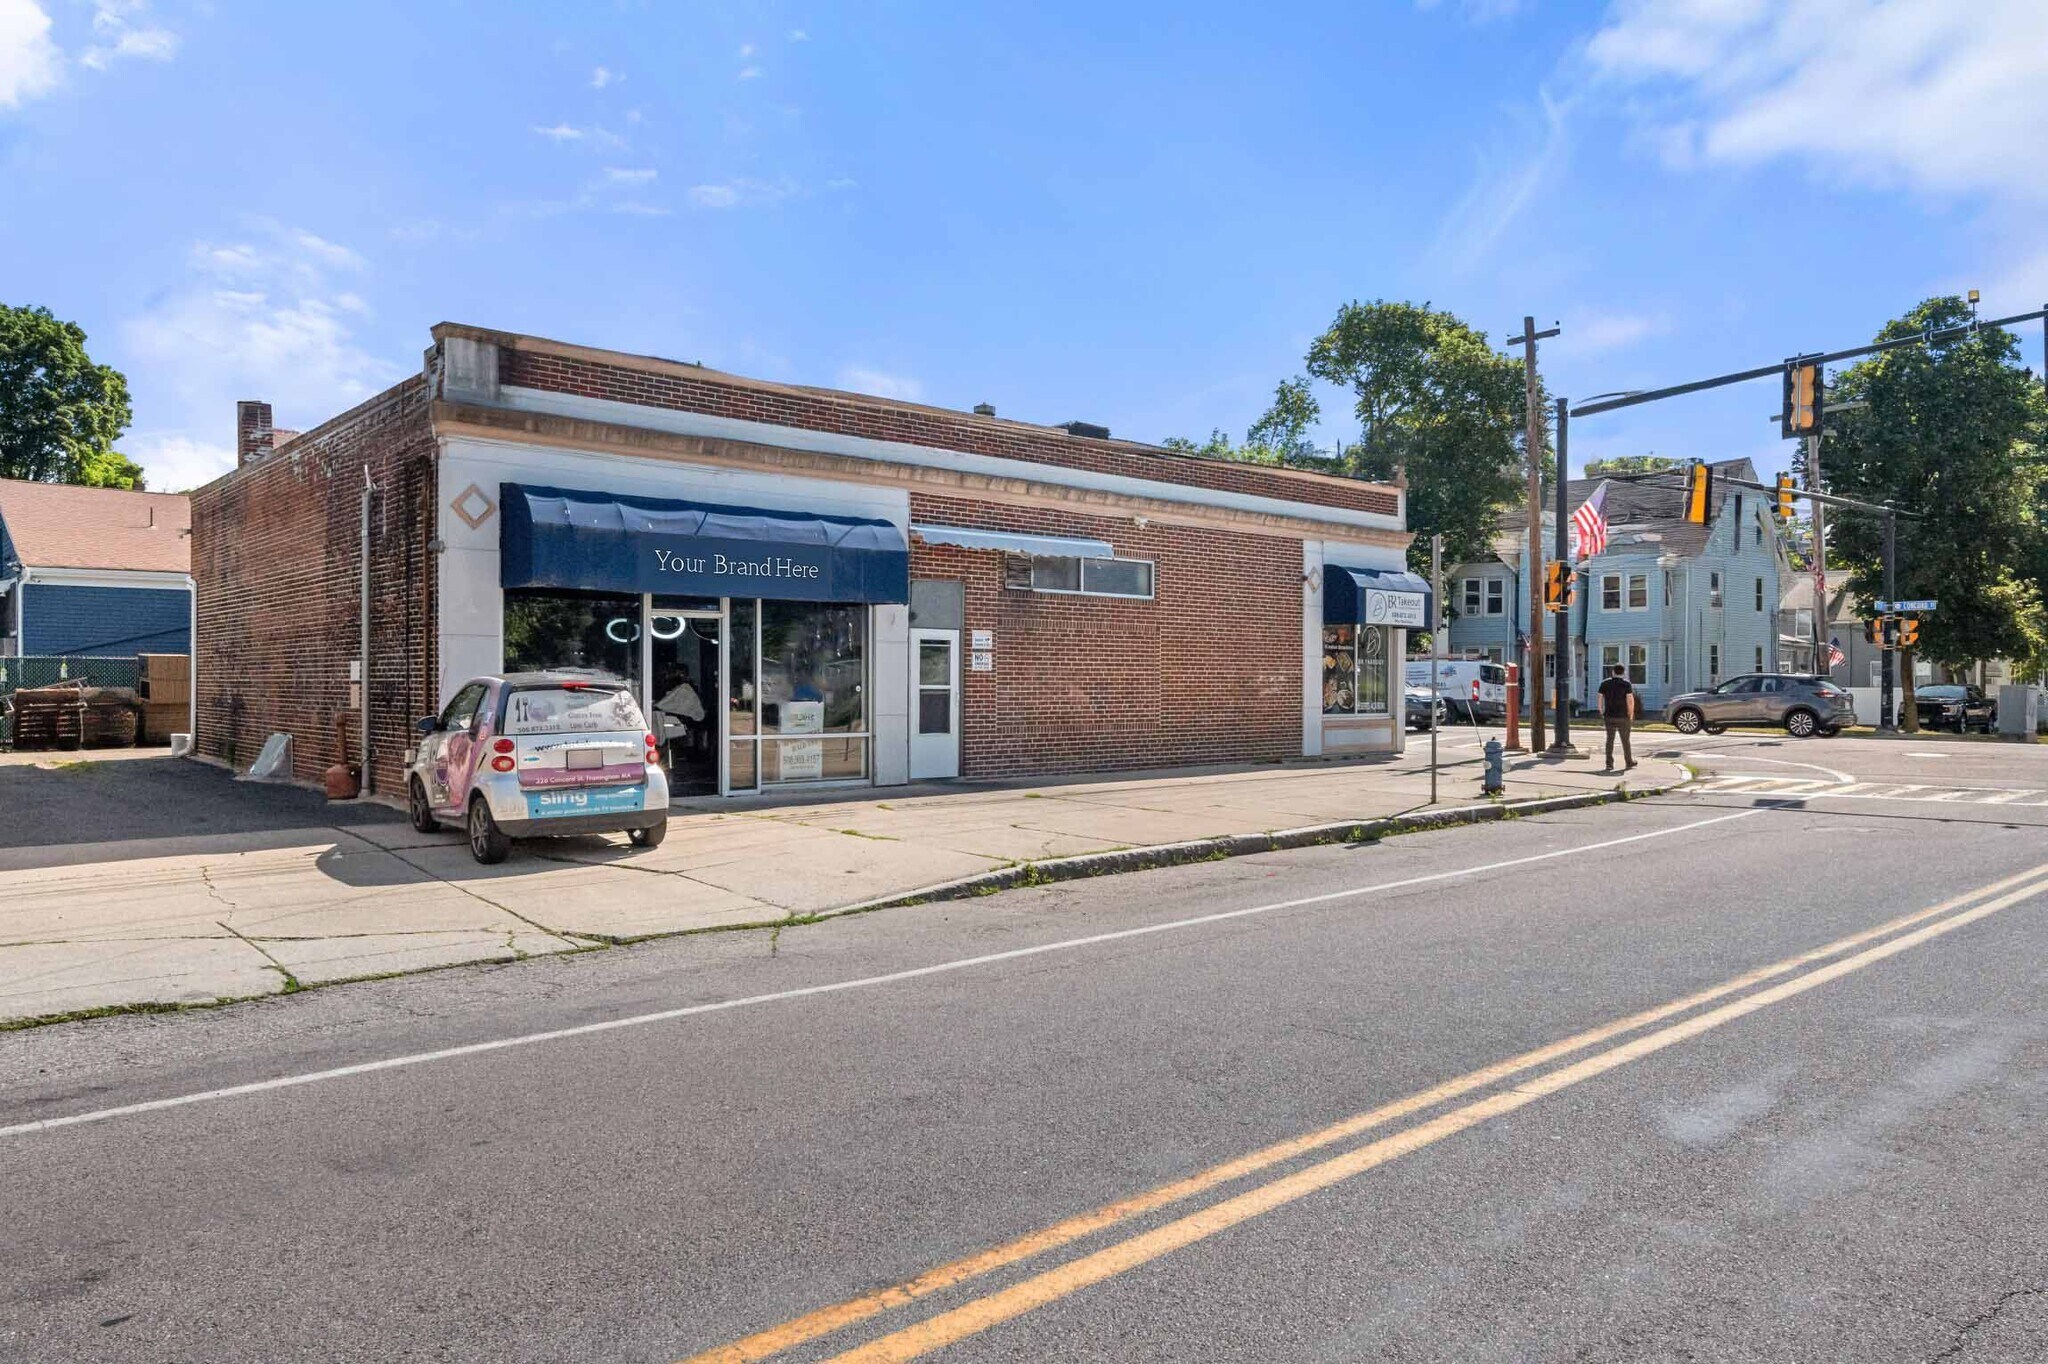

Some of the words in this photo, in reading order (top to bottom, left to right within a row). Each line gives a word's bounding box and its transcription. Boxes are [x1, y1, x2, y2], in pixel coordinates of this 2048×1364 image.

[655, 549, 705, 573] Your
[713, 554, 771, 577] Brand
[776, 557, 819, 578] Here
[1397, 596, 1420, 607] Takeout
[974, 653, 984, 662] NO
[569, 722, 581, 730] Low
[584, 721, 598, 729] Carb
[550, 775, 576, 783] Concord
[541, 792, 587, 806] sling
